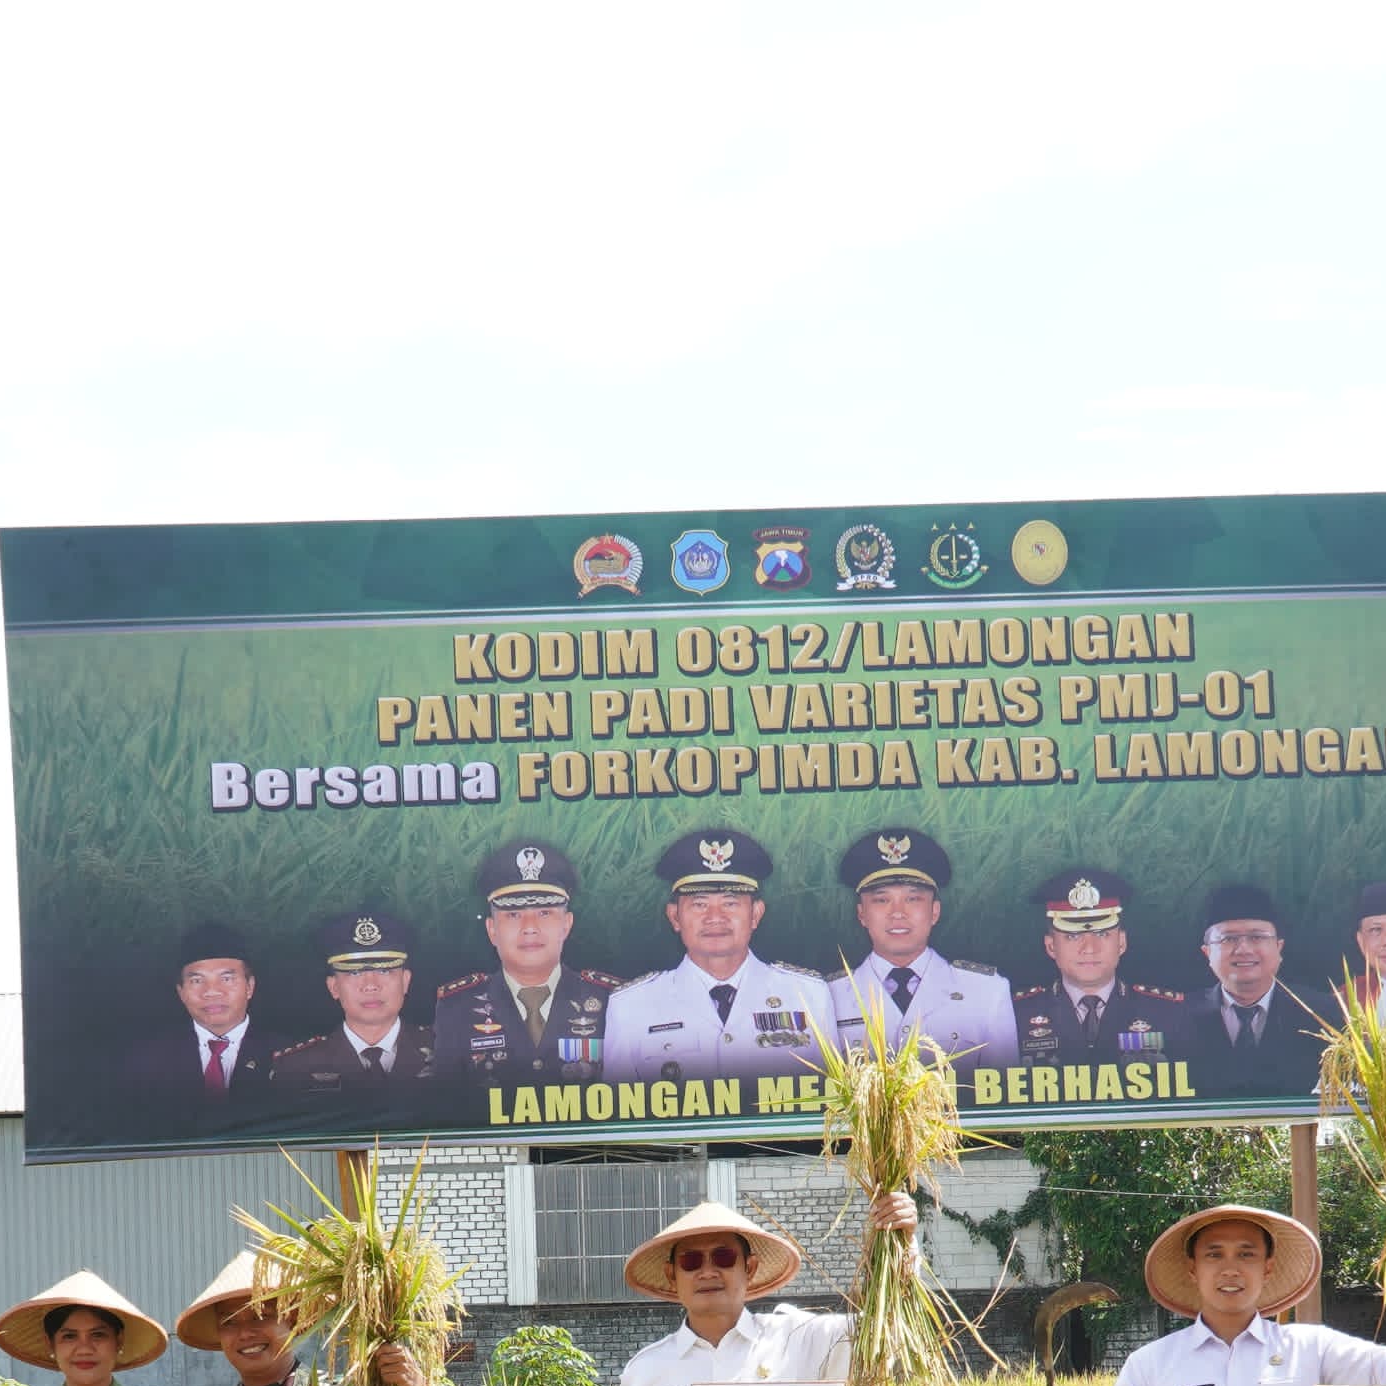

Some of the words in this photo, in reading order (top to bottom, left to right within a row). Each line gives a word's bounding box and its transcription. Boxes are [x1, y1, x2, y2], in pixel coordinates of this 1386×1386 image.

[453, 627, 659, 682] KODIM
[676, 612, 1194, 677] 0812/LAMONGAN
[377, 690, 572, 746] PANEN
[590, 686, 734, 738] PADI
[748, 673, 1043, 735] VARIETAS
[1059, 669, 1275, 724] PMJ-01
[211, 760, 501, 812] Bersama
[517, 738, 922, 802] FORKOPIMDA
[936, 734, 1079, 790] KAB.
[489, 1078, 741, 1125] LAMONGAN
[973, 1060, 1196, 1106] BERHASIL
